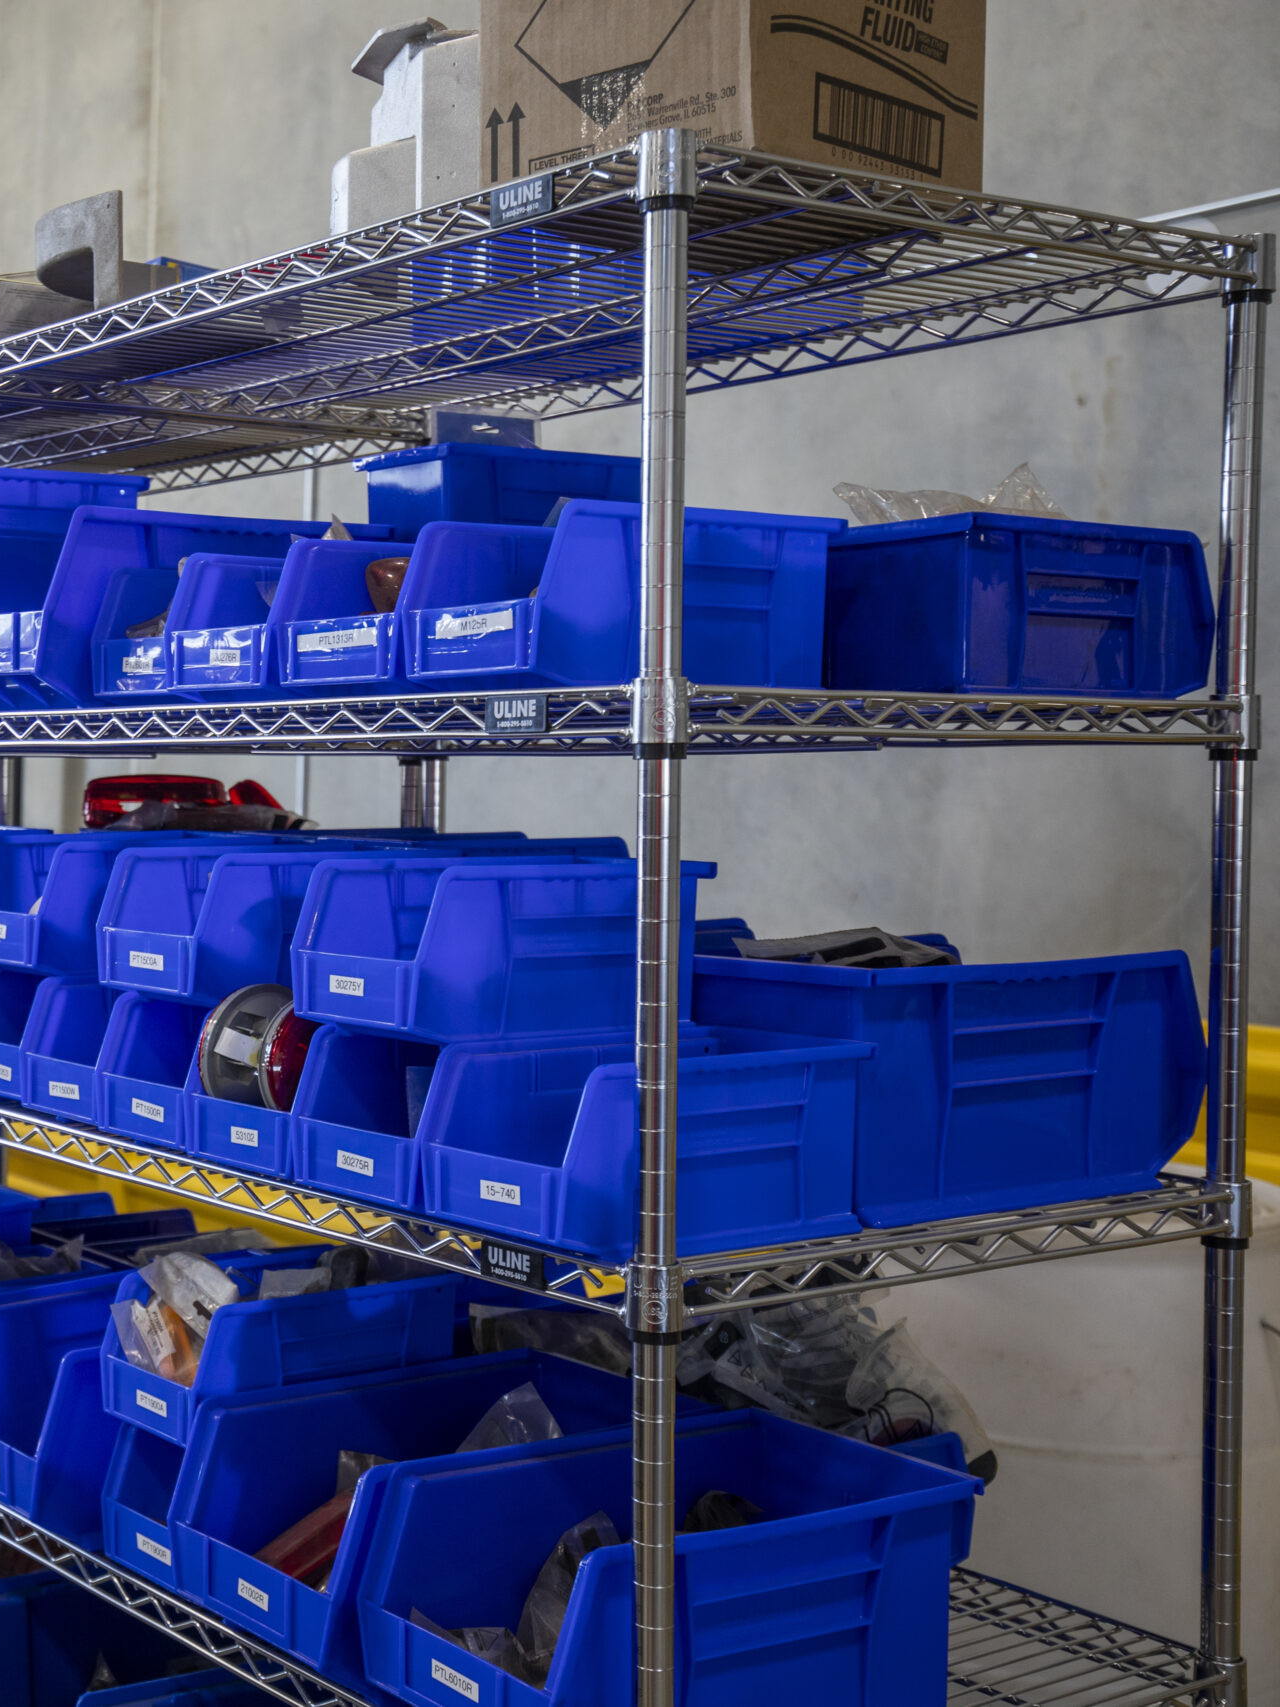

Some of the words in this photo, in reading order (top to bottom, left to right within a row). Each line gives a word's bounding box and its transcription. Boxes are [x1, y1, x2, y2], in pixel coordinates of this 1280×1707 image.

[860, 6, 916, 53] FLUID
[705, 91, 719, 102] Ste.
[720, 85, 737, 99] 300
[659, 112, 682, 126] Grove,
[691, 102, 717, 118] 60515
[534, 156, 560, 171] LEVEL
[561, 150, 588, 165] THREE
[500, 180, 543, 210] ULINE
[318, 633, 355, 645] PTL1313R
[494, 699, 537, 718] ULINE
[132, 953, 158, 967] PT1500A
[336, 978, 362, 992] 30275Y
[51, 1083, 76, 1096] PT1500W
[135, 1102, 162, 1118] PT1500R
[235, 1130, 255, 1143] 53102
[341, 1154, 369, 1172] 30275R
[486, 1185, 516, 1200] 15-740
[488, 1246, 531, 1273] ULINE
[141, 1539, 167, 1559] PT1900R
[240, 1582, 265, 1605] 21002R
[434, 1664, 473, 1694] PTL6010R
